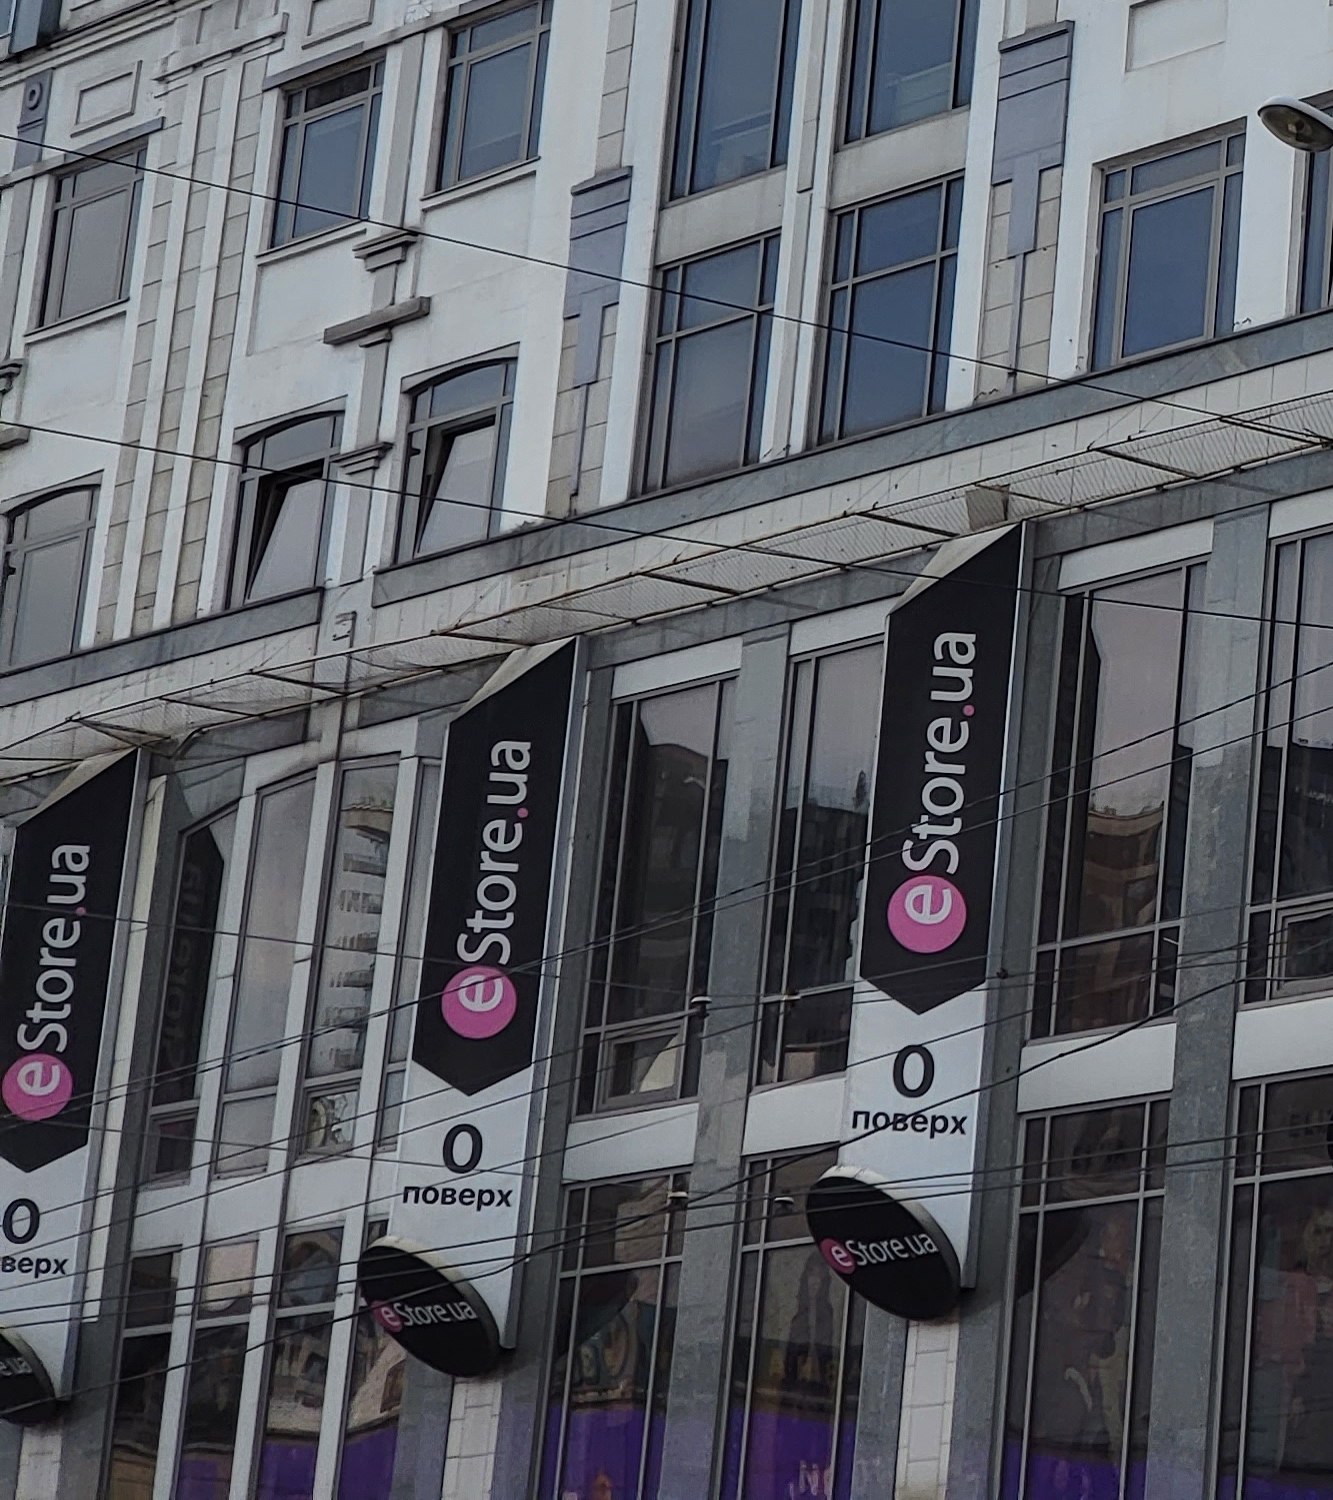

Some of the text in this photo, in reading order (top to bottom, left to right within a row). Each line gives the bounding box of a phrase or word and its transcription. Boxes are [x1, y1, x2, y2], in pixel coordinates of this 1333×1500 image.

[456, 739, 532, 1013] eStore.ua
[900, 631, 977, 926] eStore.ua
[16, 844, 91, 1097] eStore.ua
[402, 1185, 514, 1212] поверх
[850, 1108, 968, 1137] поверх
